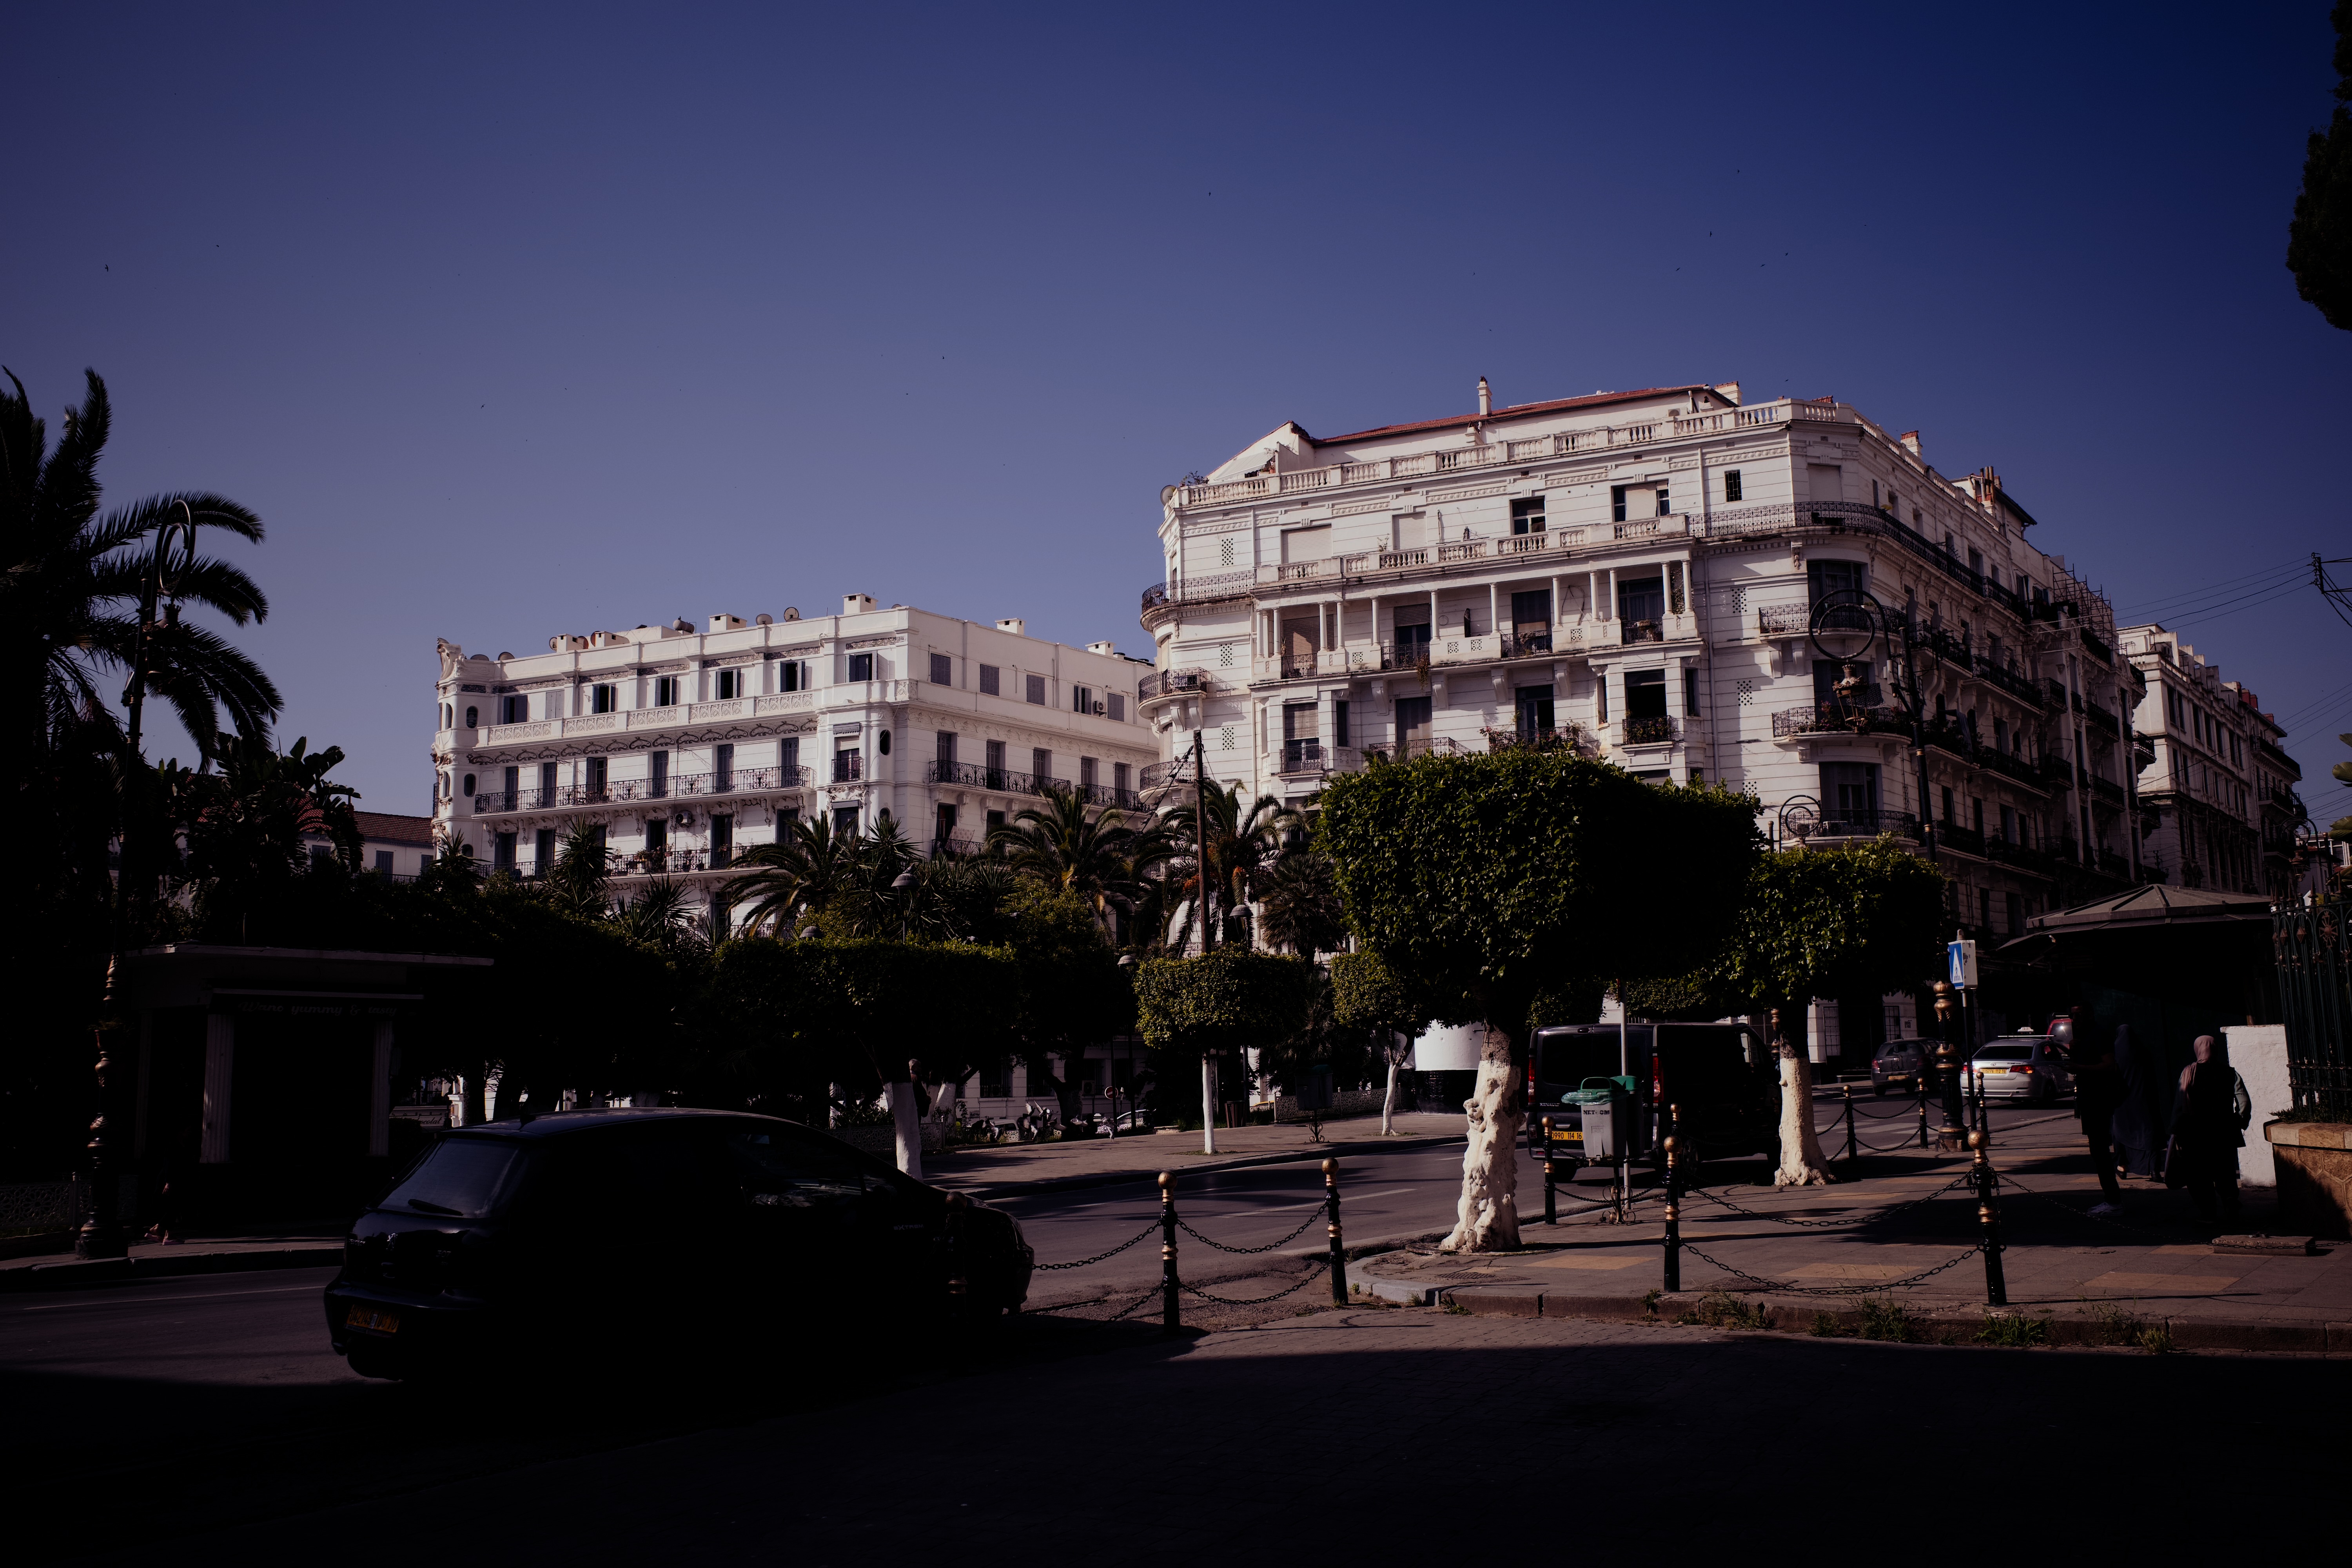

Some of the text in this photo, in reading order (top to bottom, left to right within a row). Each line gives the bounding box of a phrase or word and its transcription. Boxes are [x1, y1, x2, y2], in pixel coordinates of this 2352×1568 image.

[291, 1005, 343, 1016] yummy
[350, 1004, 361, 1016] &
[368, 1006, 397, 1016] tasty
